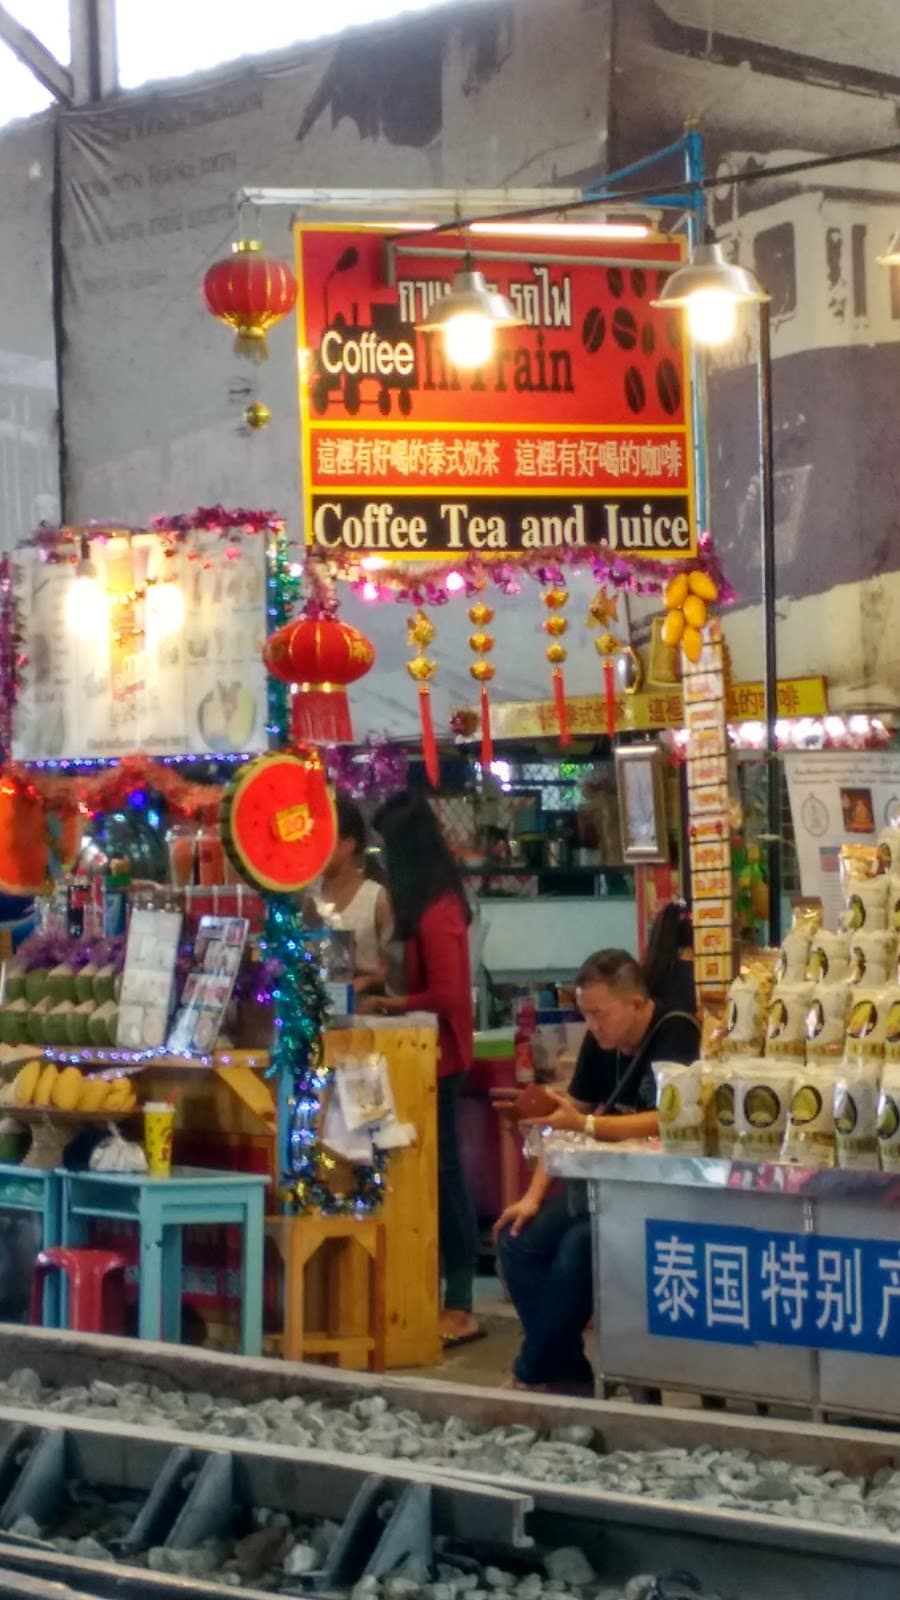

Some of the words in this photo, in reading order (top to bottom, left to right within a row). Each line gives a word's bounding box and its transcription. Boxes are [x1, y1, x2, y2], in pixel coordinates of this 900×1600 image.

[321, 331, 414, 375] Coffee
[313, 502, 428, 548] Coffee
[440, 503, 508, 548] Tea
[521, 503, 587, 548] and
[600, 503, 689, 550] Juice
